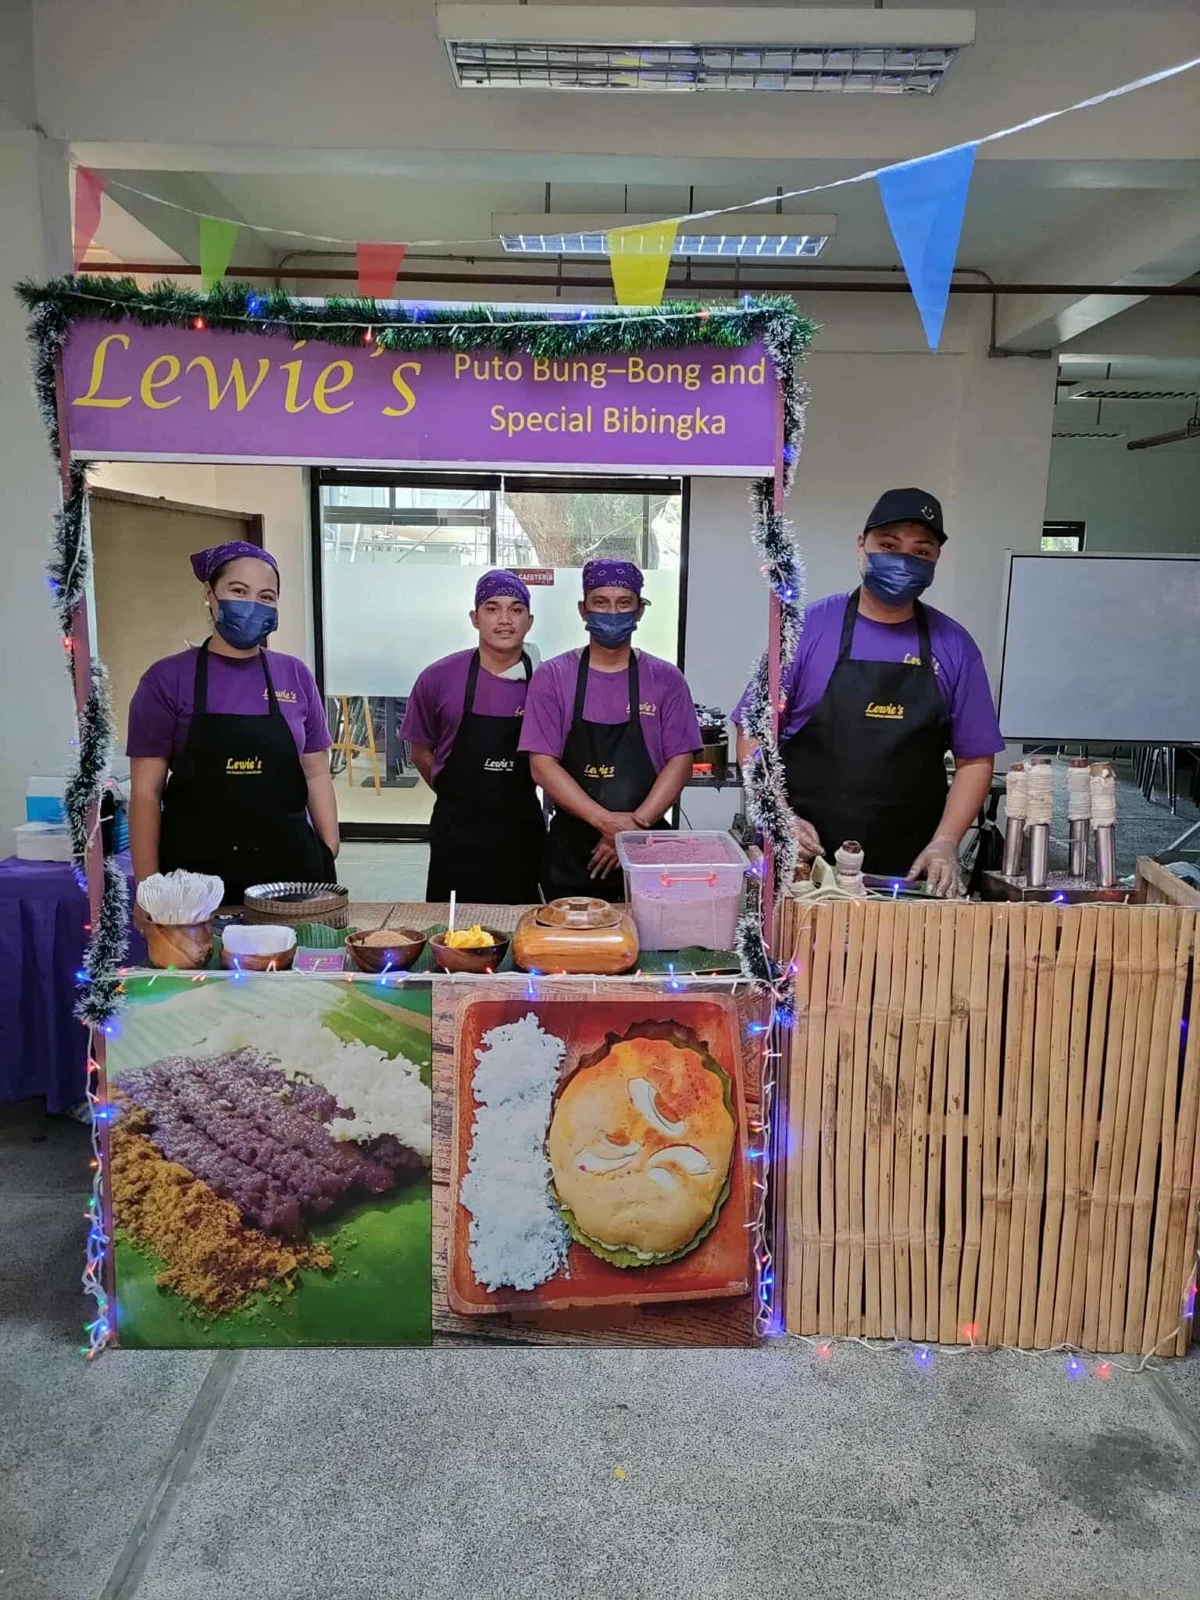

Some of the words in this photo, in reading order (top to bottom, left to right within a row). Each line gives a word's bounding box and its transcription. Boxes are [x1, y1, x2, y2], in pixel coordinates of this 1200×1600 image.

[71, 333, 422, 417] Lewie's
[454, 353, 523, 382] Puto
[711, 357, 767, 385] and
[490, 405, 593, 438] Special
[603, 407, 726, 440] Bibingka
[865, 702, 905, 715] Lewie's
[225, 756, 262, 770] Lewie's
